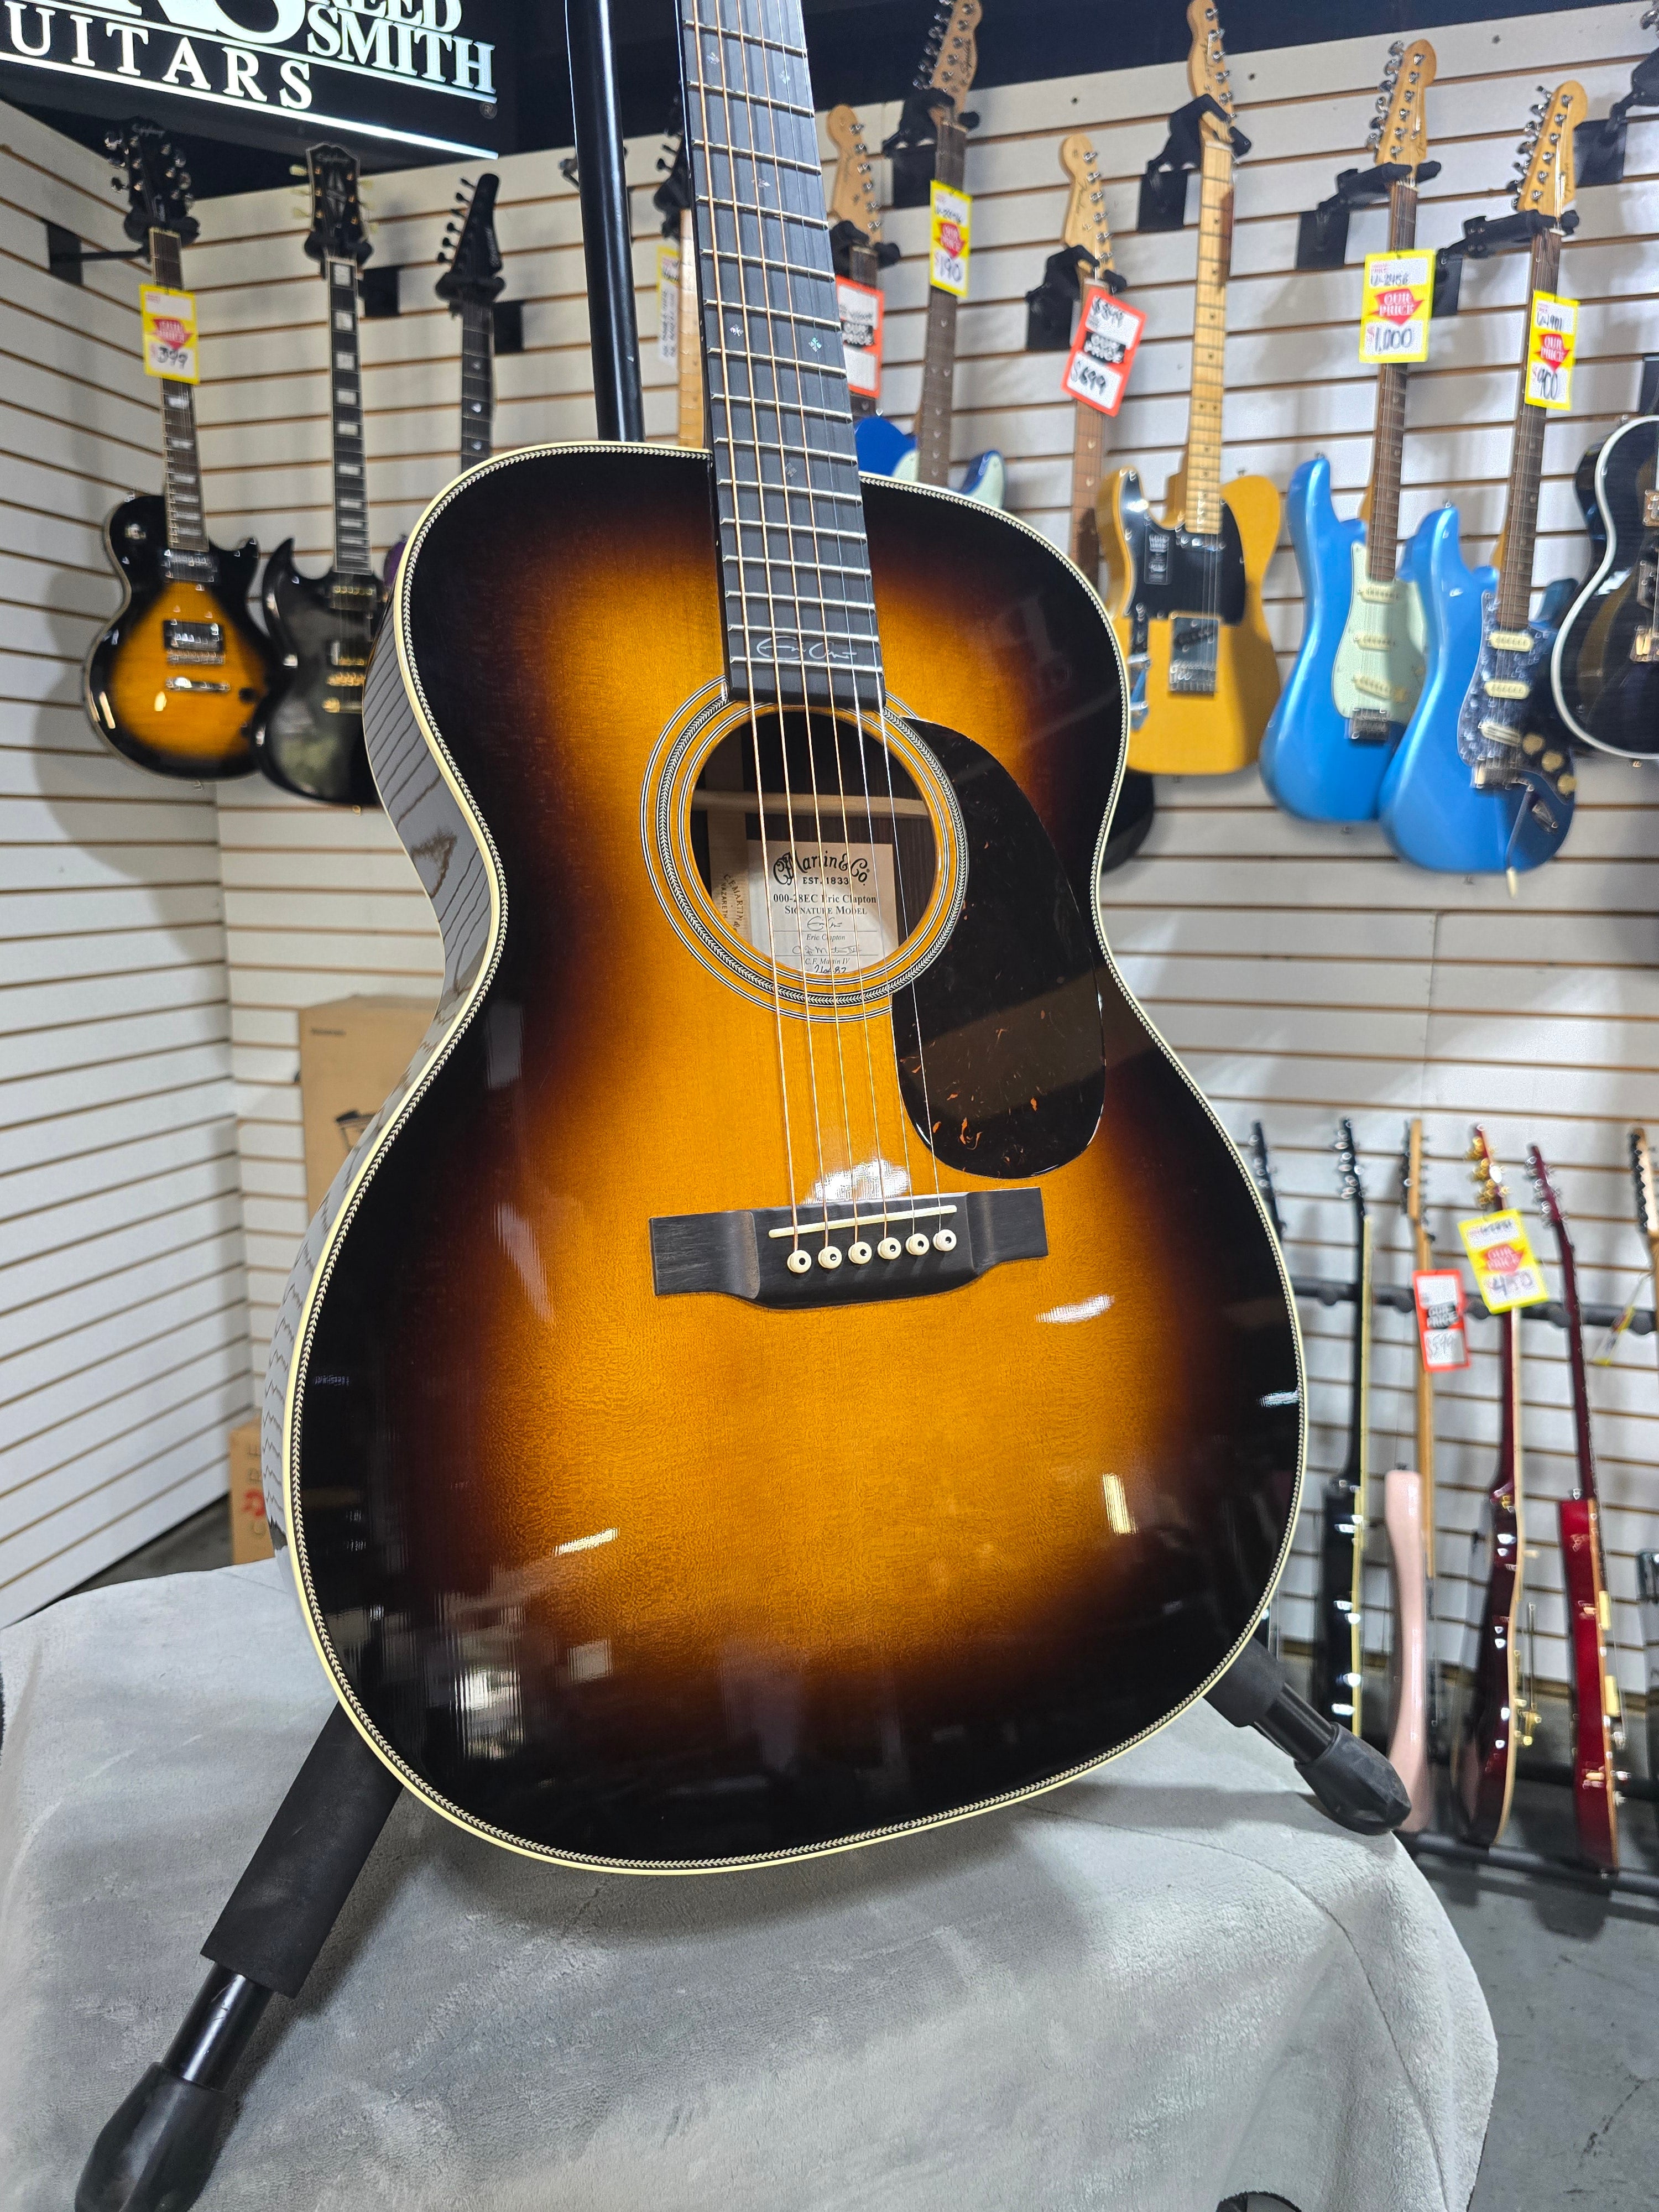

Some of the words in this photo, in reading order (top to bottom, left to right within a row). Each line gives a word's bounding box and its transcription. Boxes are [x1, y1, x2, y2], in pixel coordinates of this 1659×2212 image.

[307, 4, 497, 94] SMITH
[1384, 291, 1411, 305] OUR
[1379, 303, 1415, 317] PRICE
[1544, 335, 1562, 351] OUR
[1541, 346, 1566, 363] PRICE
[826, 877, 849, 885] 1833
[821, 934, 846, 942] Capton
